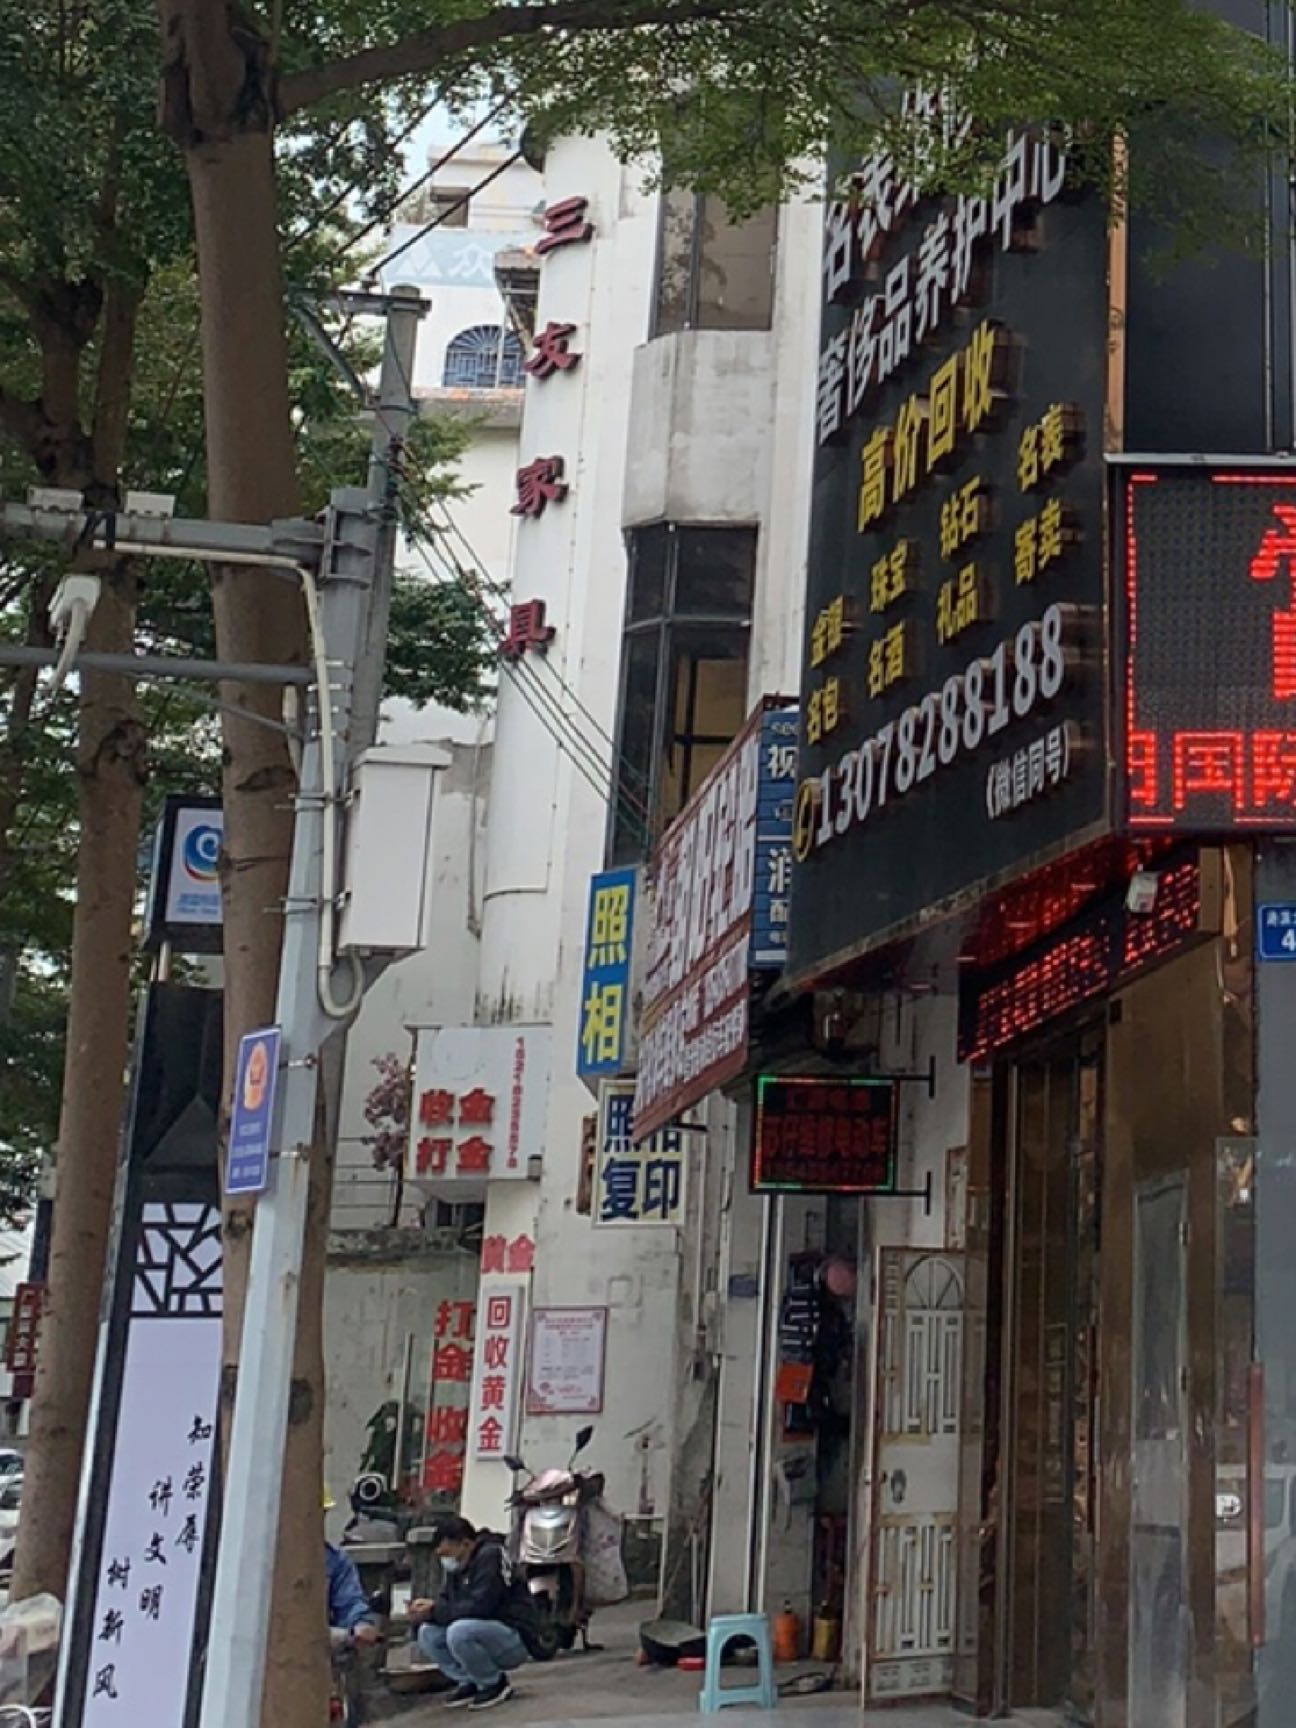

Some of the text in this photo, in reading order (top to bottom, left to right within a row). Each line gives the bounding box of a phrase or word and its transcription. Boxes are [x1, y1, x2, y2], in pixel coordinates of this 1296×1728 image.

[816, 124, 1071, 446] 奢侈品养护中心
[502, 196, 594, 662] 三友家具
[858, 319, 995, 533] 高价回收
[870, 539, 908, 613] 珠宝
[939, 475, 980, 559] 钻石
[1016, 403, 1065, 492] 名表
[868, 622, 906, 699] 名酒
[936, 562, 979, 645] 礼品
[816, 603, 1065, 847] 13078288188
[583, 884, 629, 1066] 照相
[416, 1136, 494, 1175] 打金
[420, 1087, 495, 1130] 收金
[601, 1158, 681, 1219] 复印
[477, 1295, 512, 1453] 回收黄金
[139, 1476, 175, 1622] 讲文明
